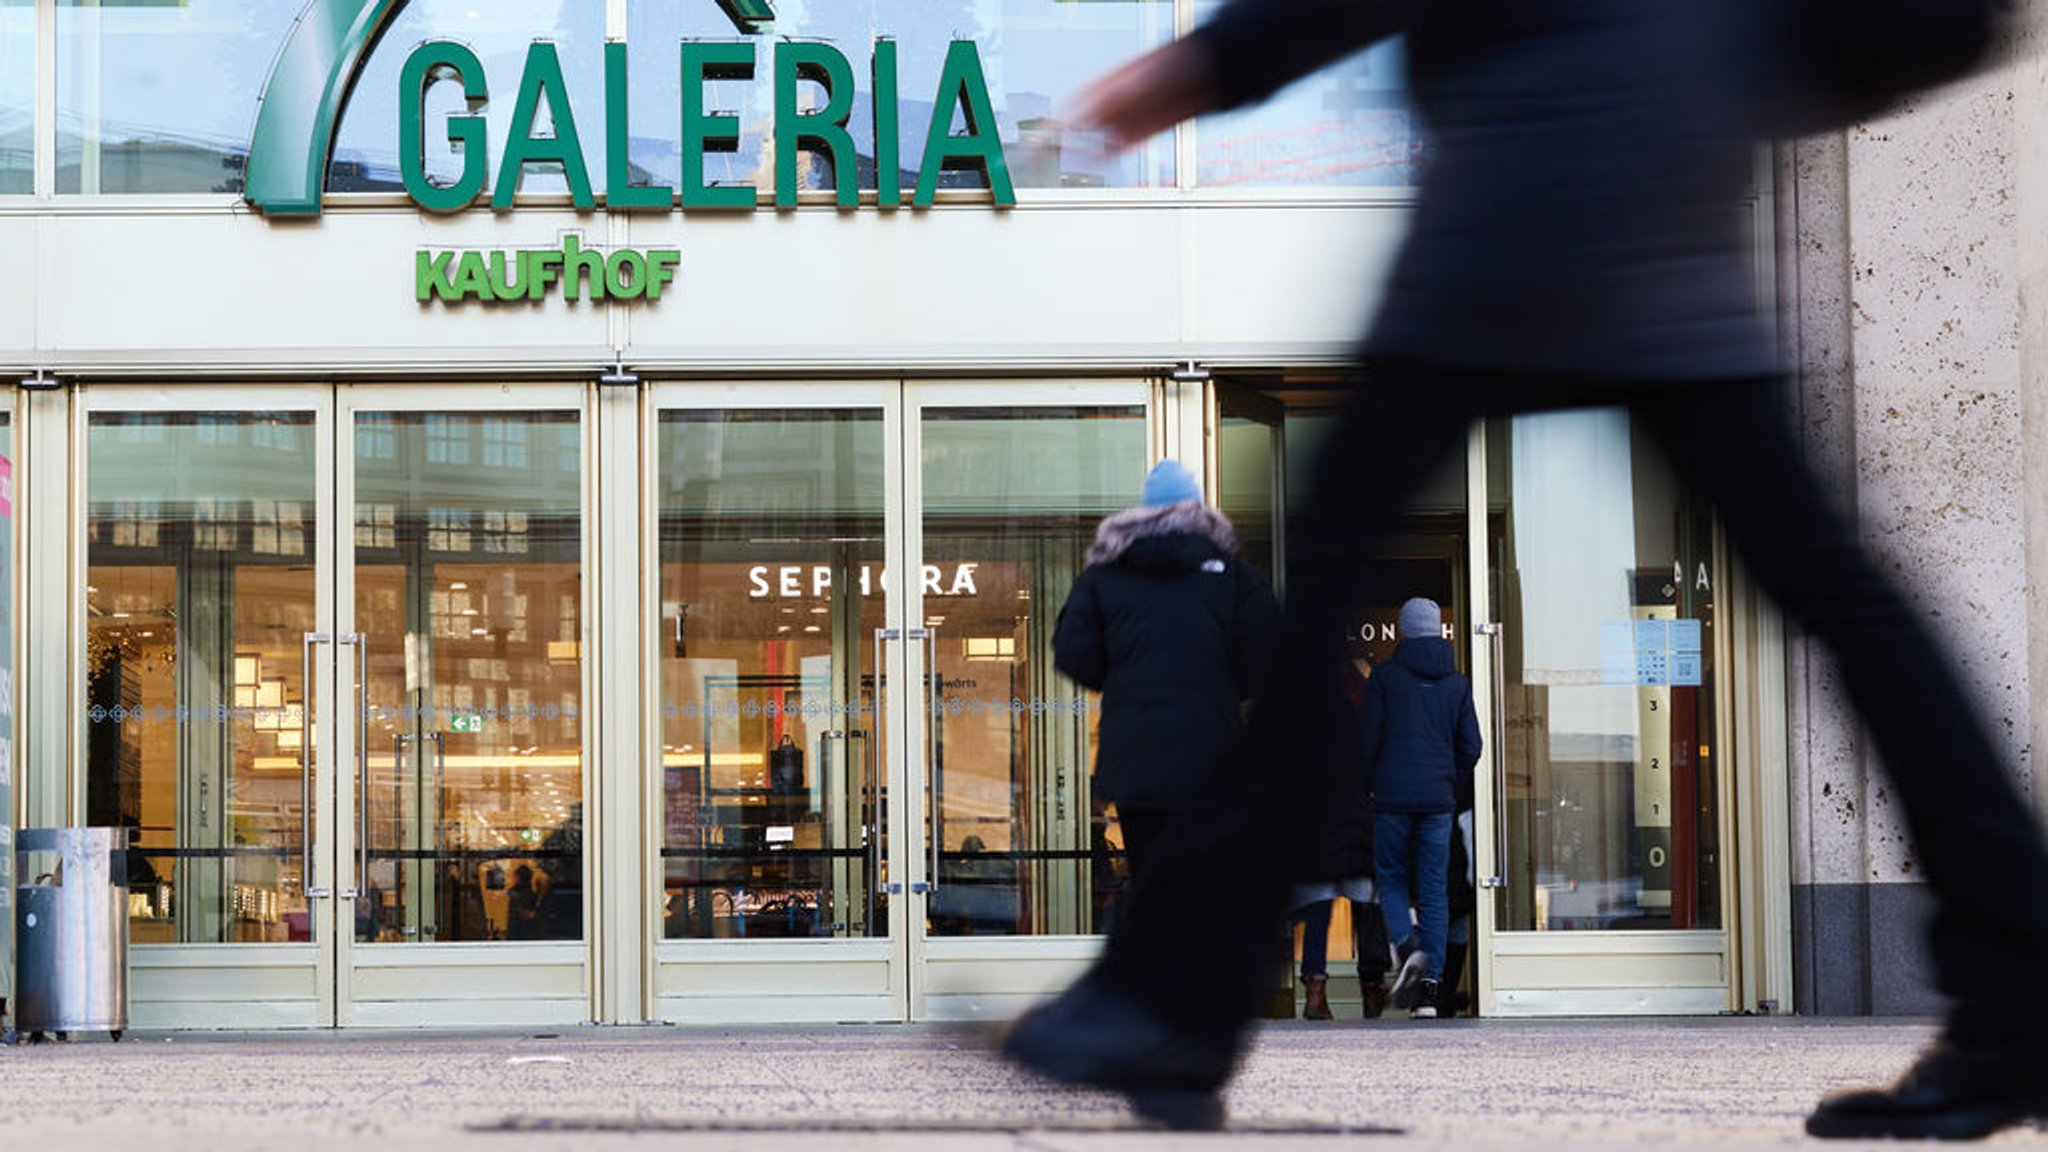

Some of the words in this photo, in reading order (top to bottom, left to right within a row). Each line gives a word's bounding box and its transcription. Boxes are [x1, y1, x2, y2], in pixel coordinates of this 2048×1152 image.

[401, 40, 1015, 211] GALERIA
[1649, 700, 1658, 711] 3
[1651, 758, 1659, 769] 2
[1652, 804, 1659, 815] 1
